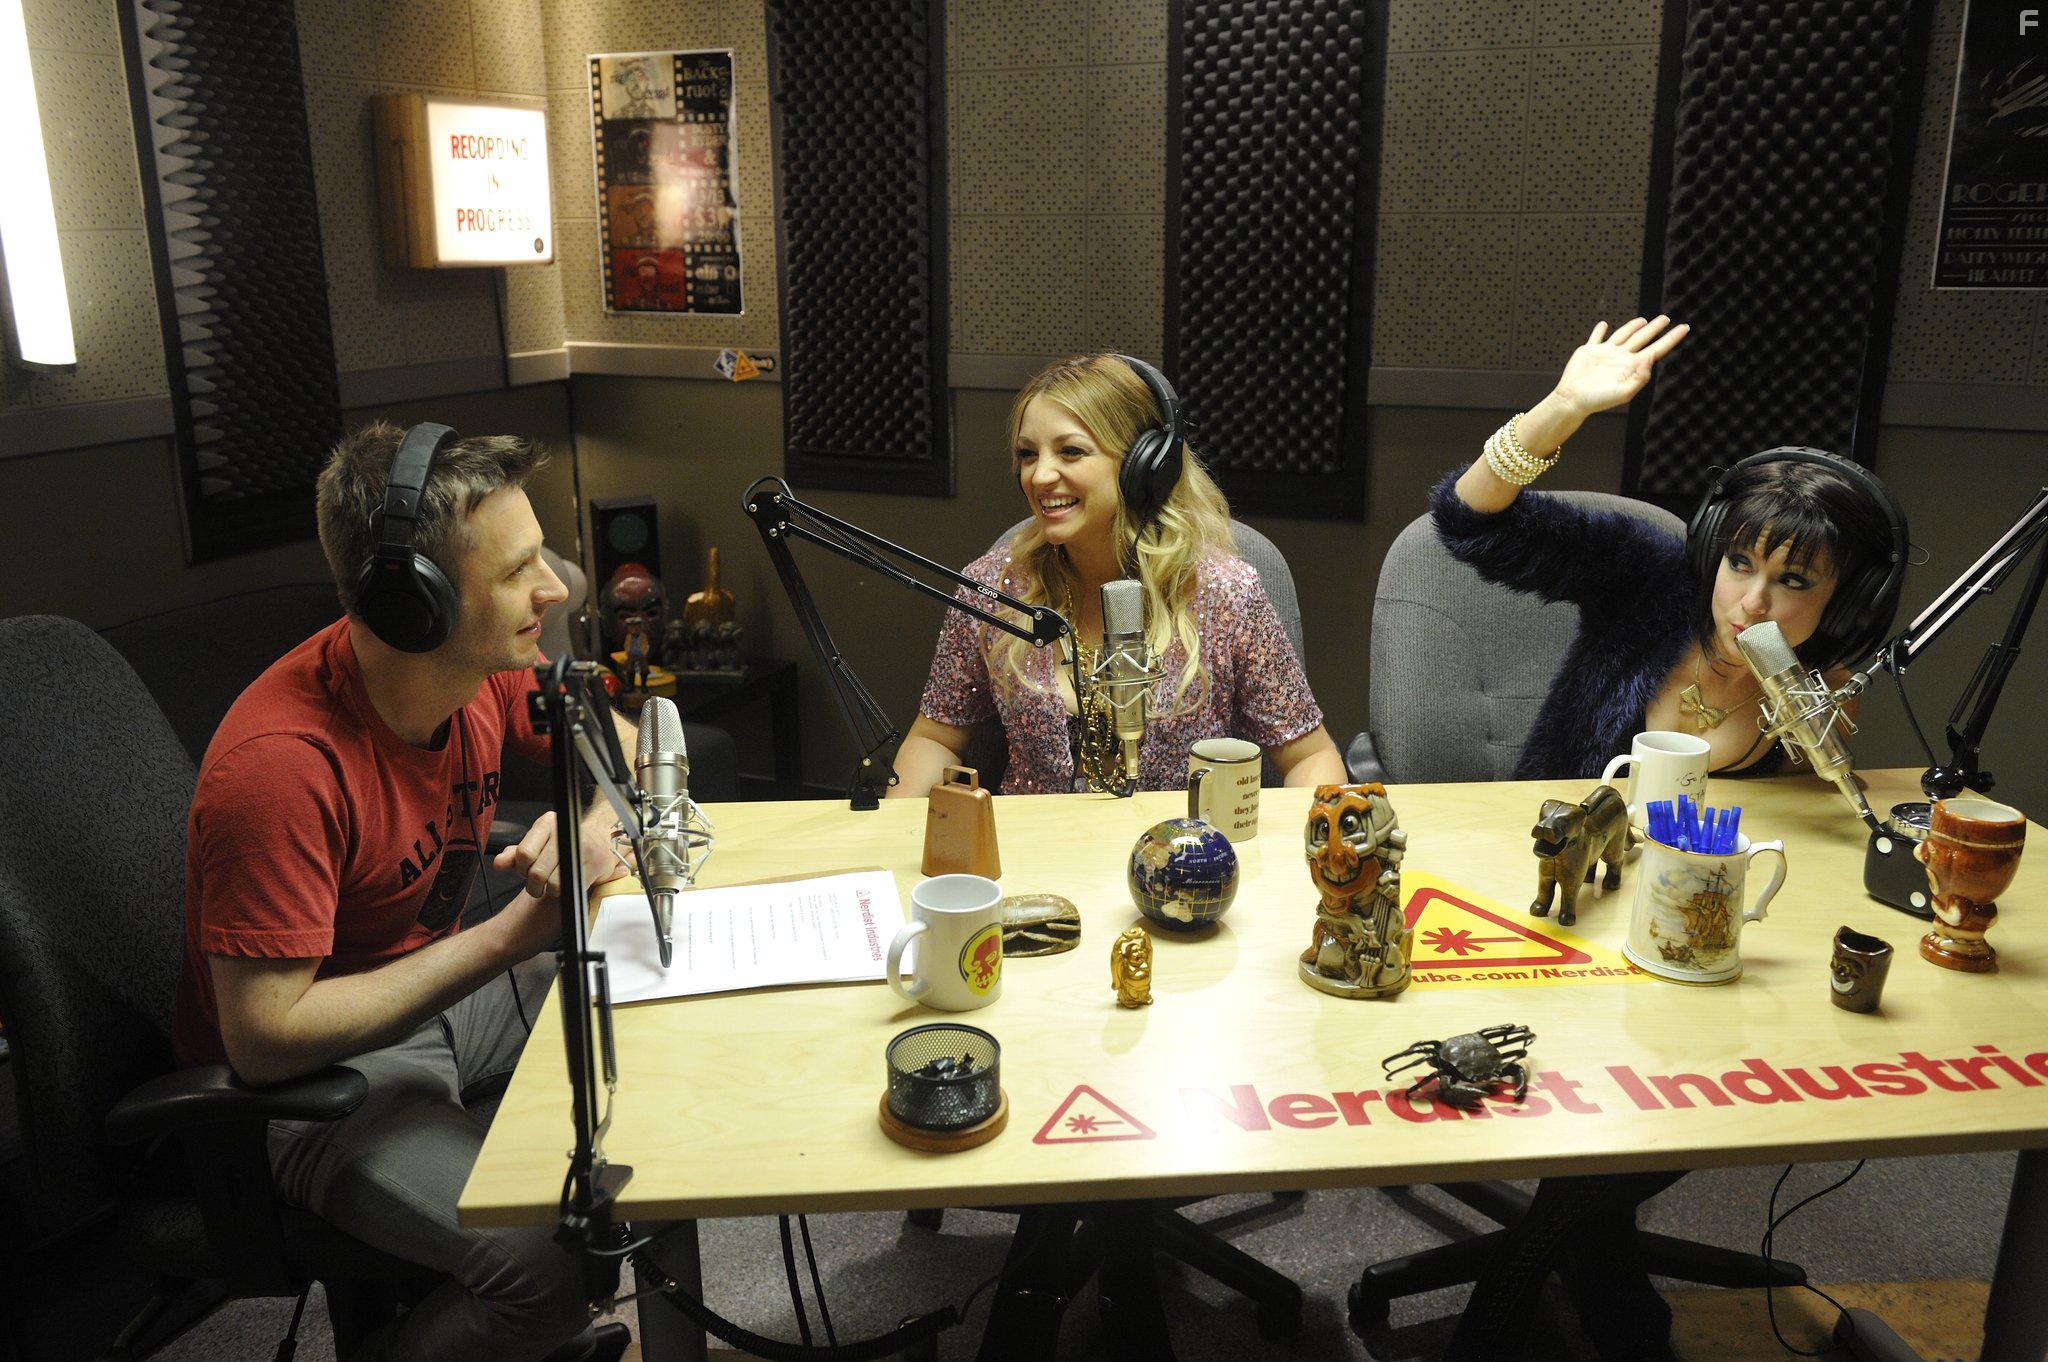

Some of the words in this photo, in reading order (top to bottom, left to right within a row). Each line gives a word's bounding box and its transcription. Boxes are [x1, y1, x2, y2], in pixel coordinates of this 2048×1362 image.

[450, 134, 528, 160] RECORDING
[456, 208, 534, 232] PROGRESS
[1236, 776, 1249, 786] old
[1234, 806, 1249, 815] they
[859, 898, 876, 926] Nerdist
[865, 926, 883, 961] Industries
[1411, 964, 1643, 985] ube.com/Nerdist
